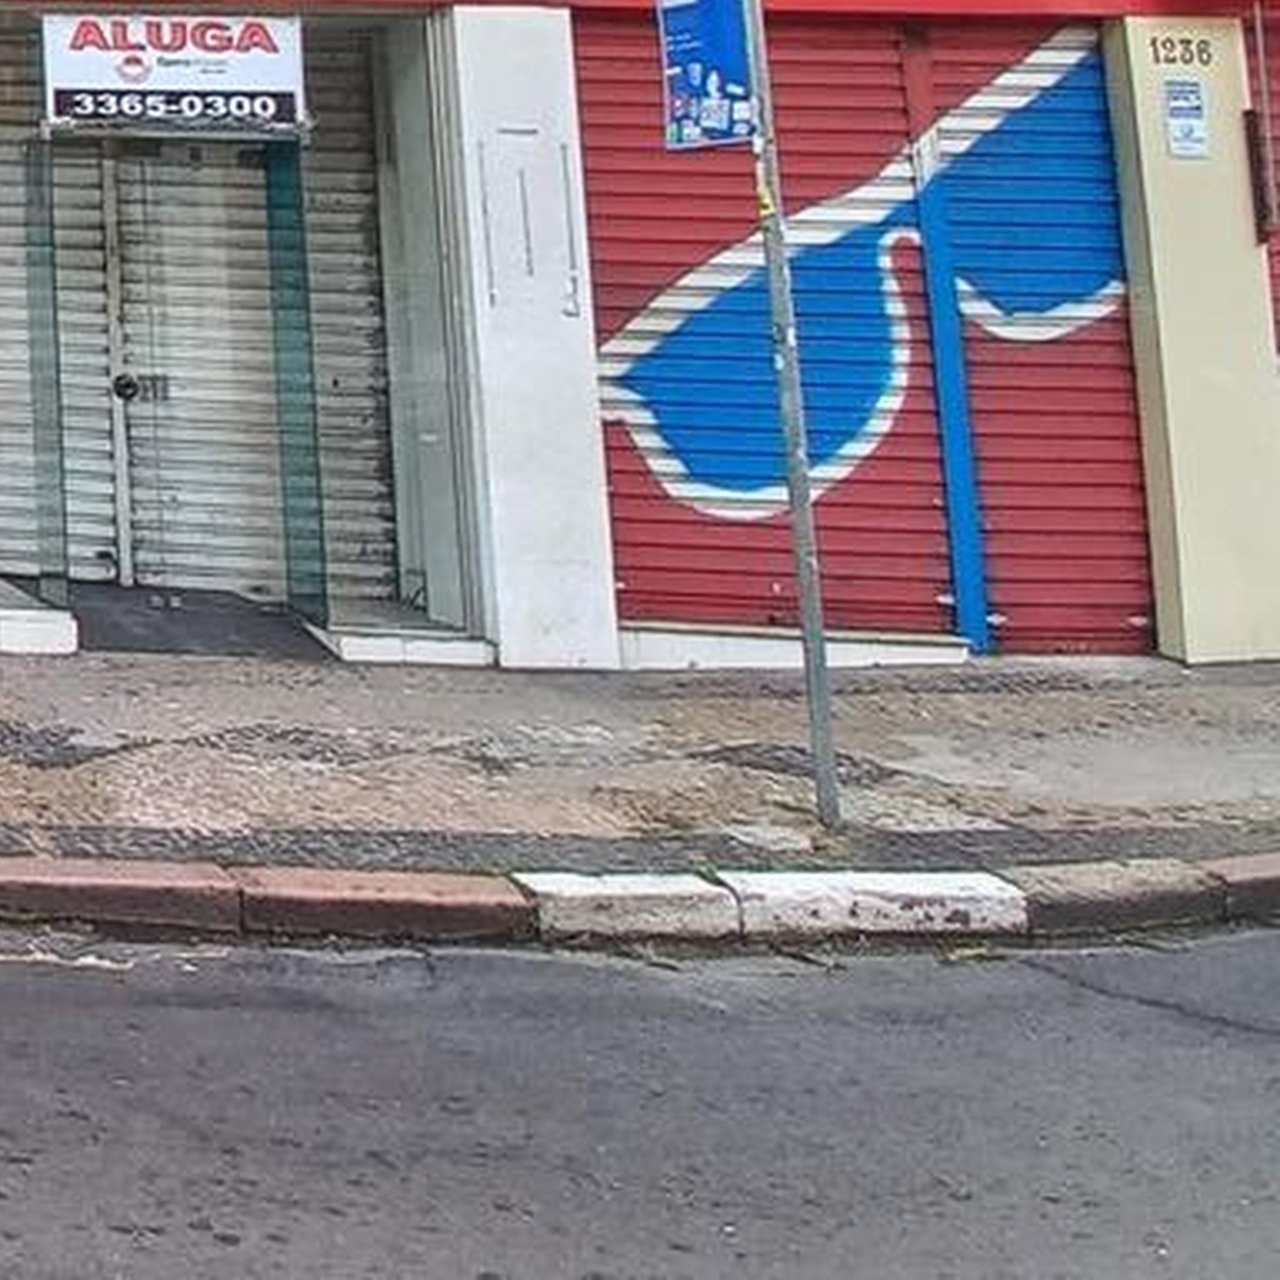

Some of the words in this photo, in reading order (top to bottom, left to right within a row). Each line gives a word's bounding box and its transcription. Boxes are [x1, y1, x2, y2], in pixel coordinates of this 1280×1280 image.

[69, 19, 280, 55] ALUGA
[1150, 37, 1213, 66] 1236
[73, 93, 277, 118] 3365-0300
